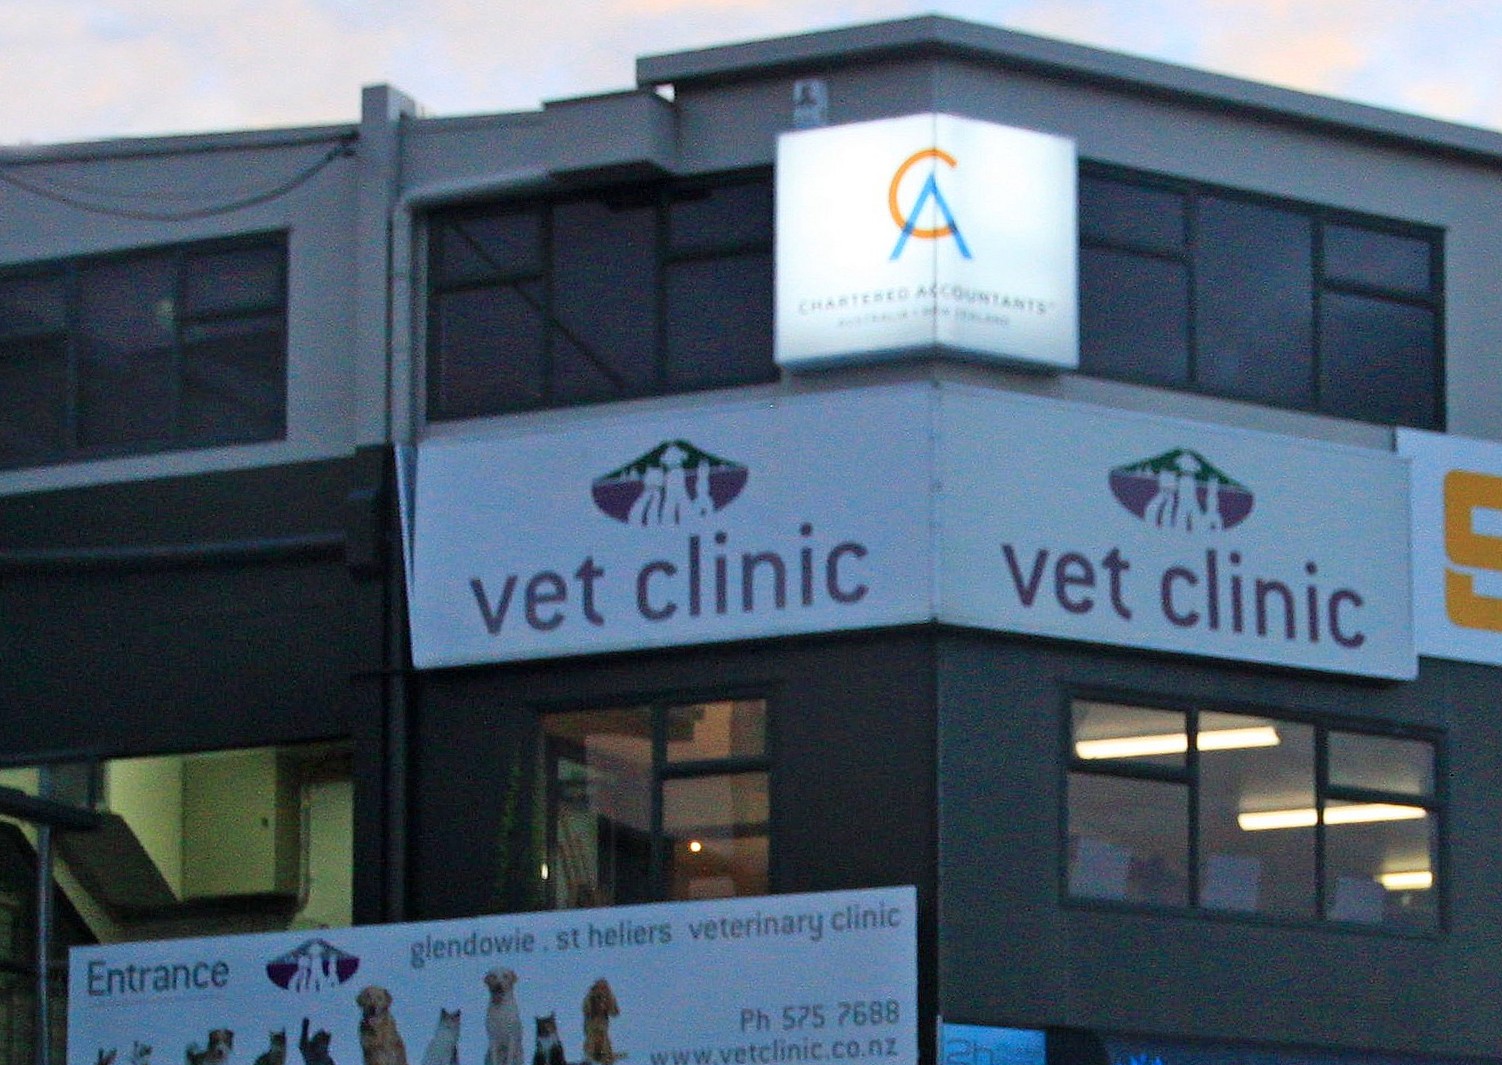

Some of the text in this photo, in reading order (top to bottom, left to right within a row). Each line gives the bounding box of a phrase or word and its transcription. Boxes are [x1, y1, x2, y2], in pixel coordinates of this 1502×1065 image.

[799, 283, 1047, 316] CHARTERED ACCOUNTANTS
[470, 524, 870, 636] vet clinic
[1001, 540, 1366, 650] vet clinic
[410, 902, 901, 969] glendowie st heliers veterinary clinic
[86, 959, 230, 996] Entrance
[740, 1000, 900, 1032] Ph 575 7688
